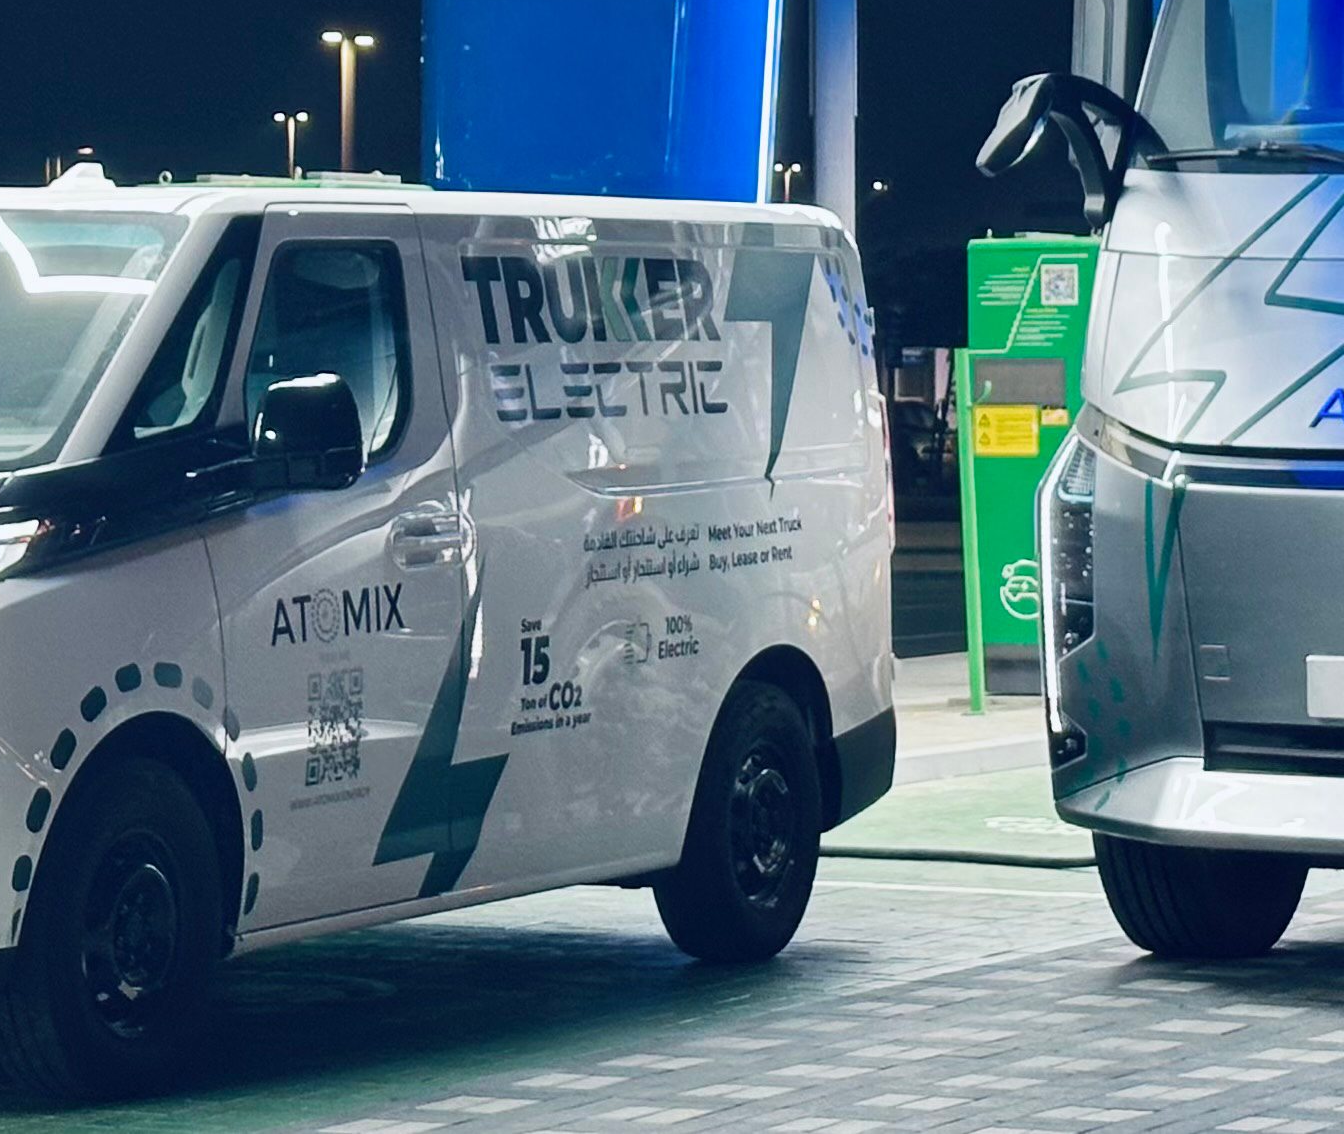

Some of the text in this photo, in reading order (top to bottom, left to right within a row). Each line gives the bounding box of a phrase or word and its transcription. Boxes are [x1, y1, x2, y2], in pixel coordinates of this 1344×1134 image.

[490, 361, 729, 422] ELECTRIC
[619, 525, 656, 548] شاحنتك
[657, 525, 674, 549] على
[675, 523, 700, 547] تعرف
[708, 516, 803, 542] Meet Your Next Truck
[667, 549, 677, 579] أو
[678, 551, 700, 577] شراء
[709, 545, 792, 573] Buy, Lease or Rent
[271, 582, 406, 647] ATOMIX
[520, 618, 542, 633] Save
[665, 614, 692, 635] 100%
[520, 635, 550, 685] 15
[658, 635, 700, 660] Electric
[520, 680, 582, 712] Ton of CO2
[511, 717, 554, 736] Emissions
[555, 715, 563, 729] in
[572, 712, 592, 730] year
